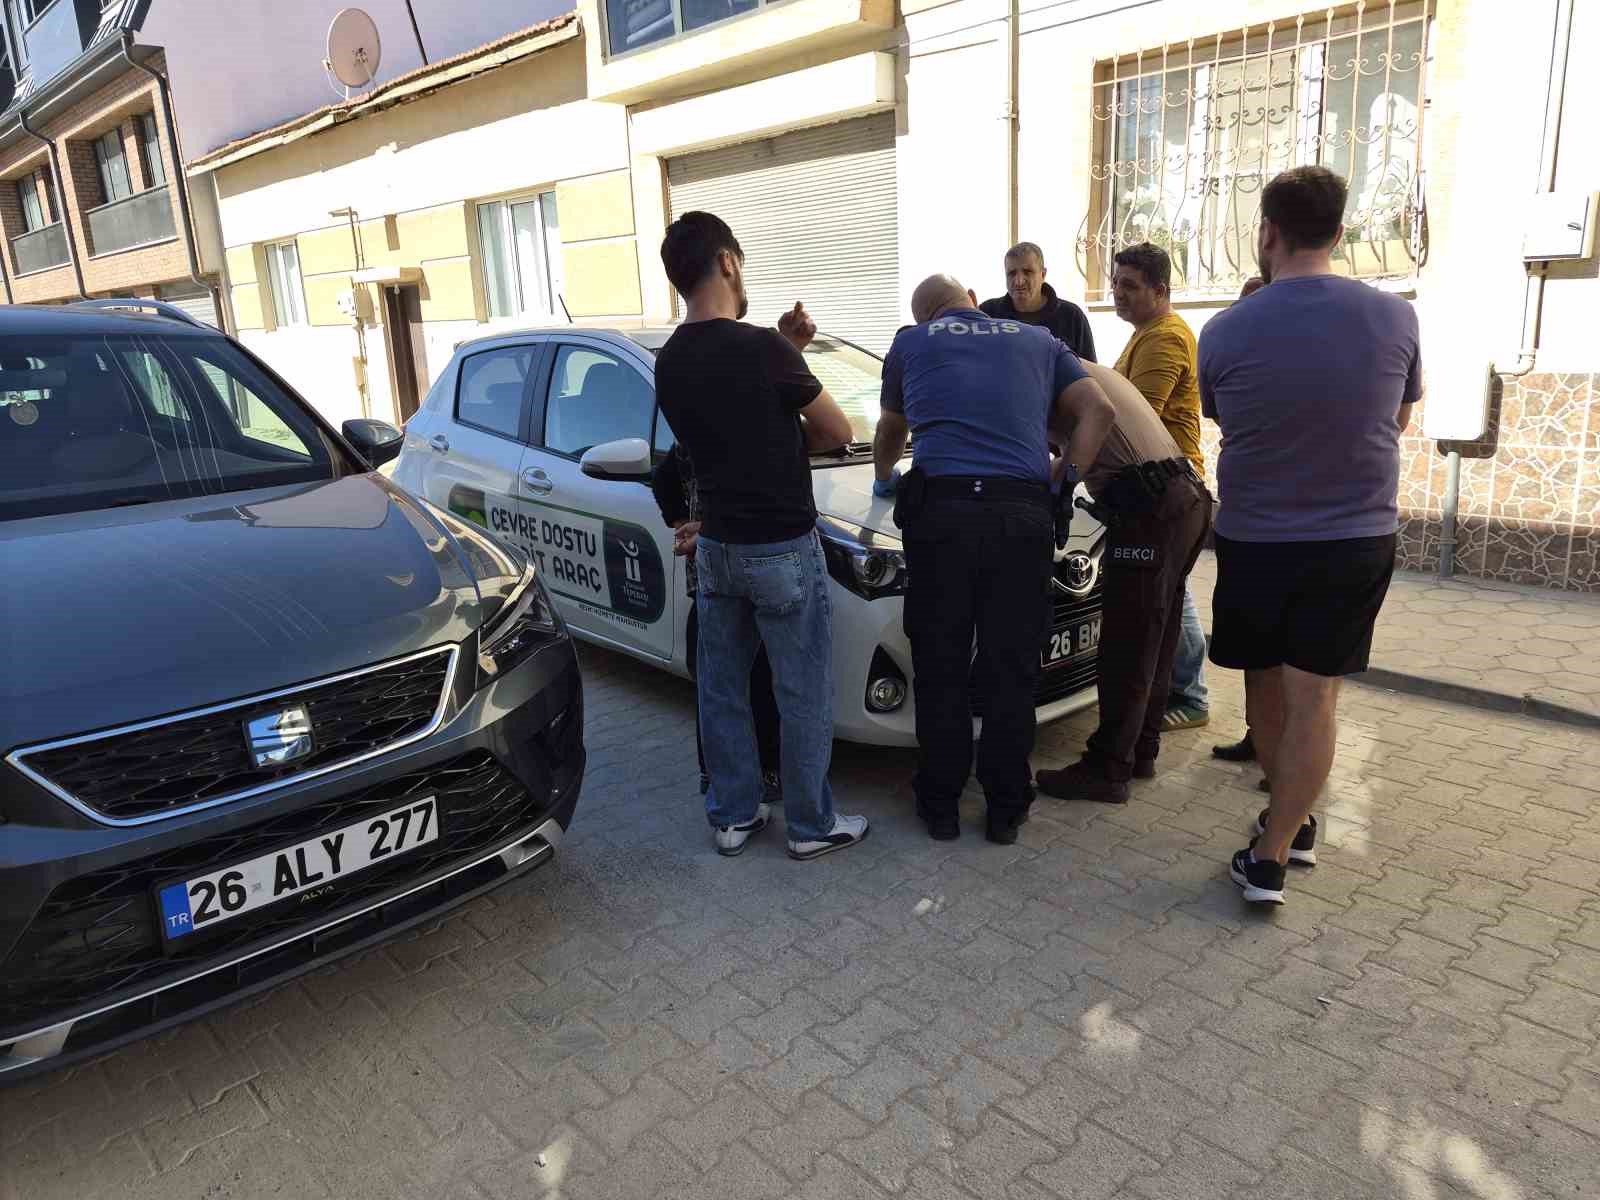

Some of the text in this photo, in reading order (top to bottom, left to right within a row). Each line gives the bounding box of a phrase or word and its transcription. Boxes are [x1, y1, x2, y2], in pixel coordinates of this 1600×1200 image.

[927, 321, 1020, 336] POLİS
[541, 520, 597, 557] DOSTU
[552, 555, 602, 593] ARAÇ
[1050, 630, 1071, 660] 26
[188, 801, 433, 925] 26 ALY 277
[168, 912, 189, 928] TR
